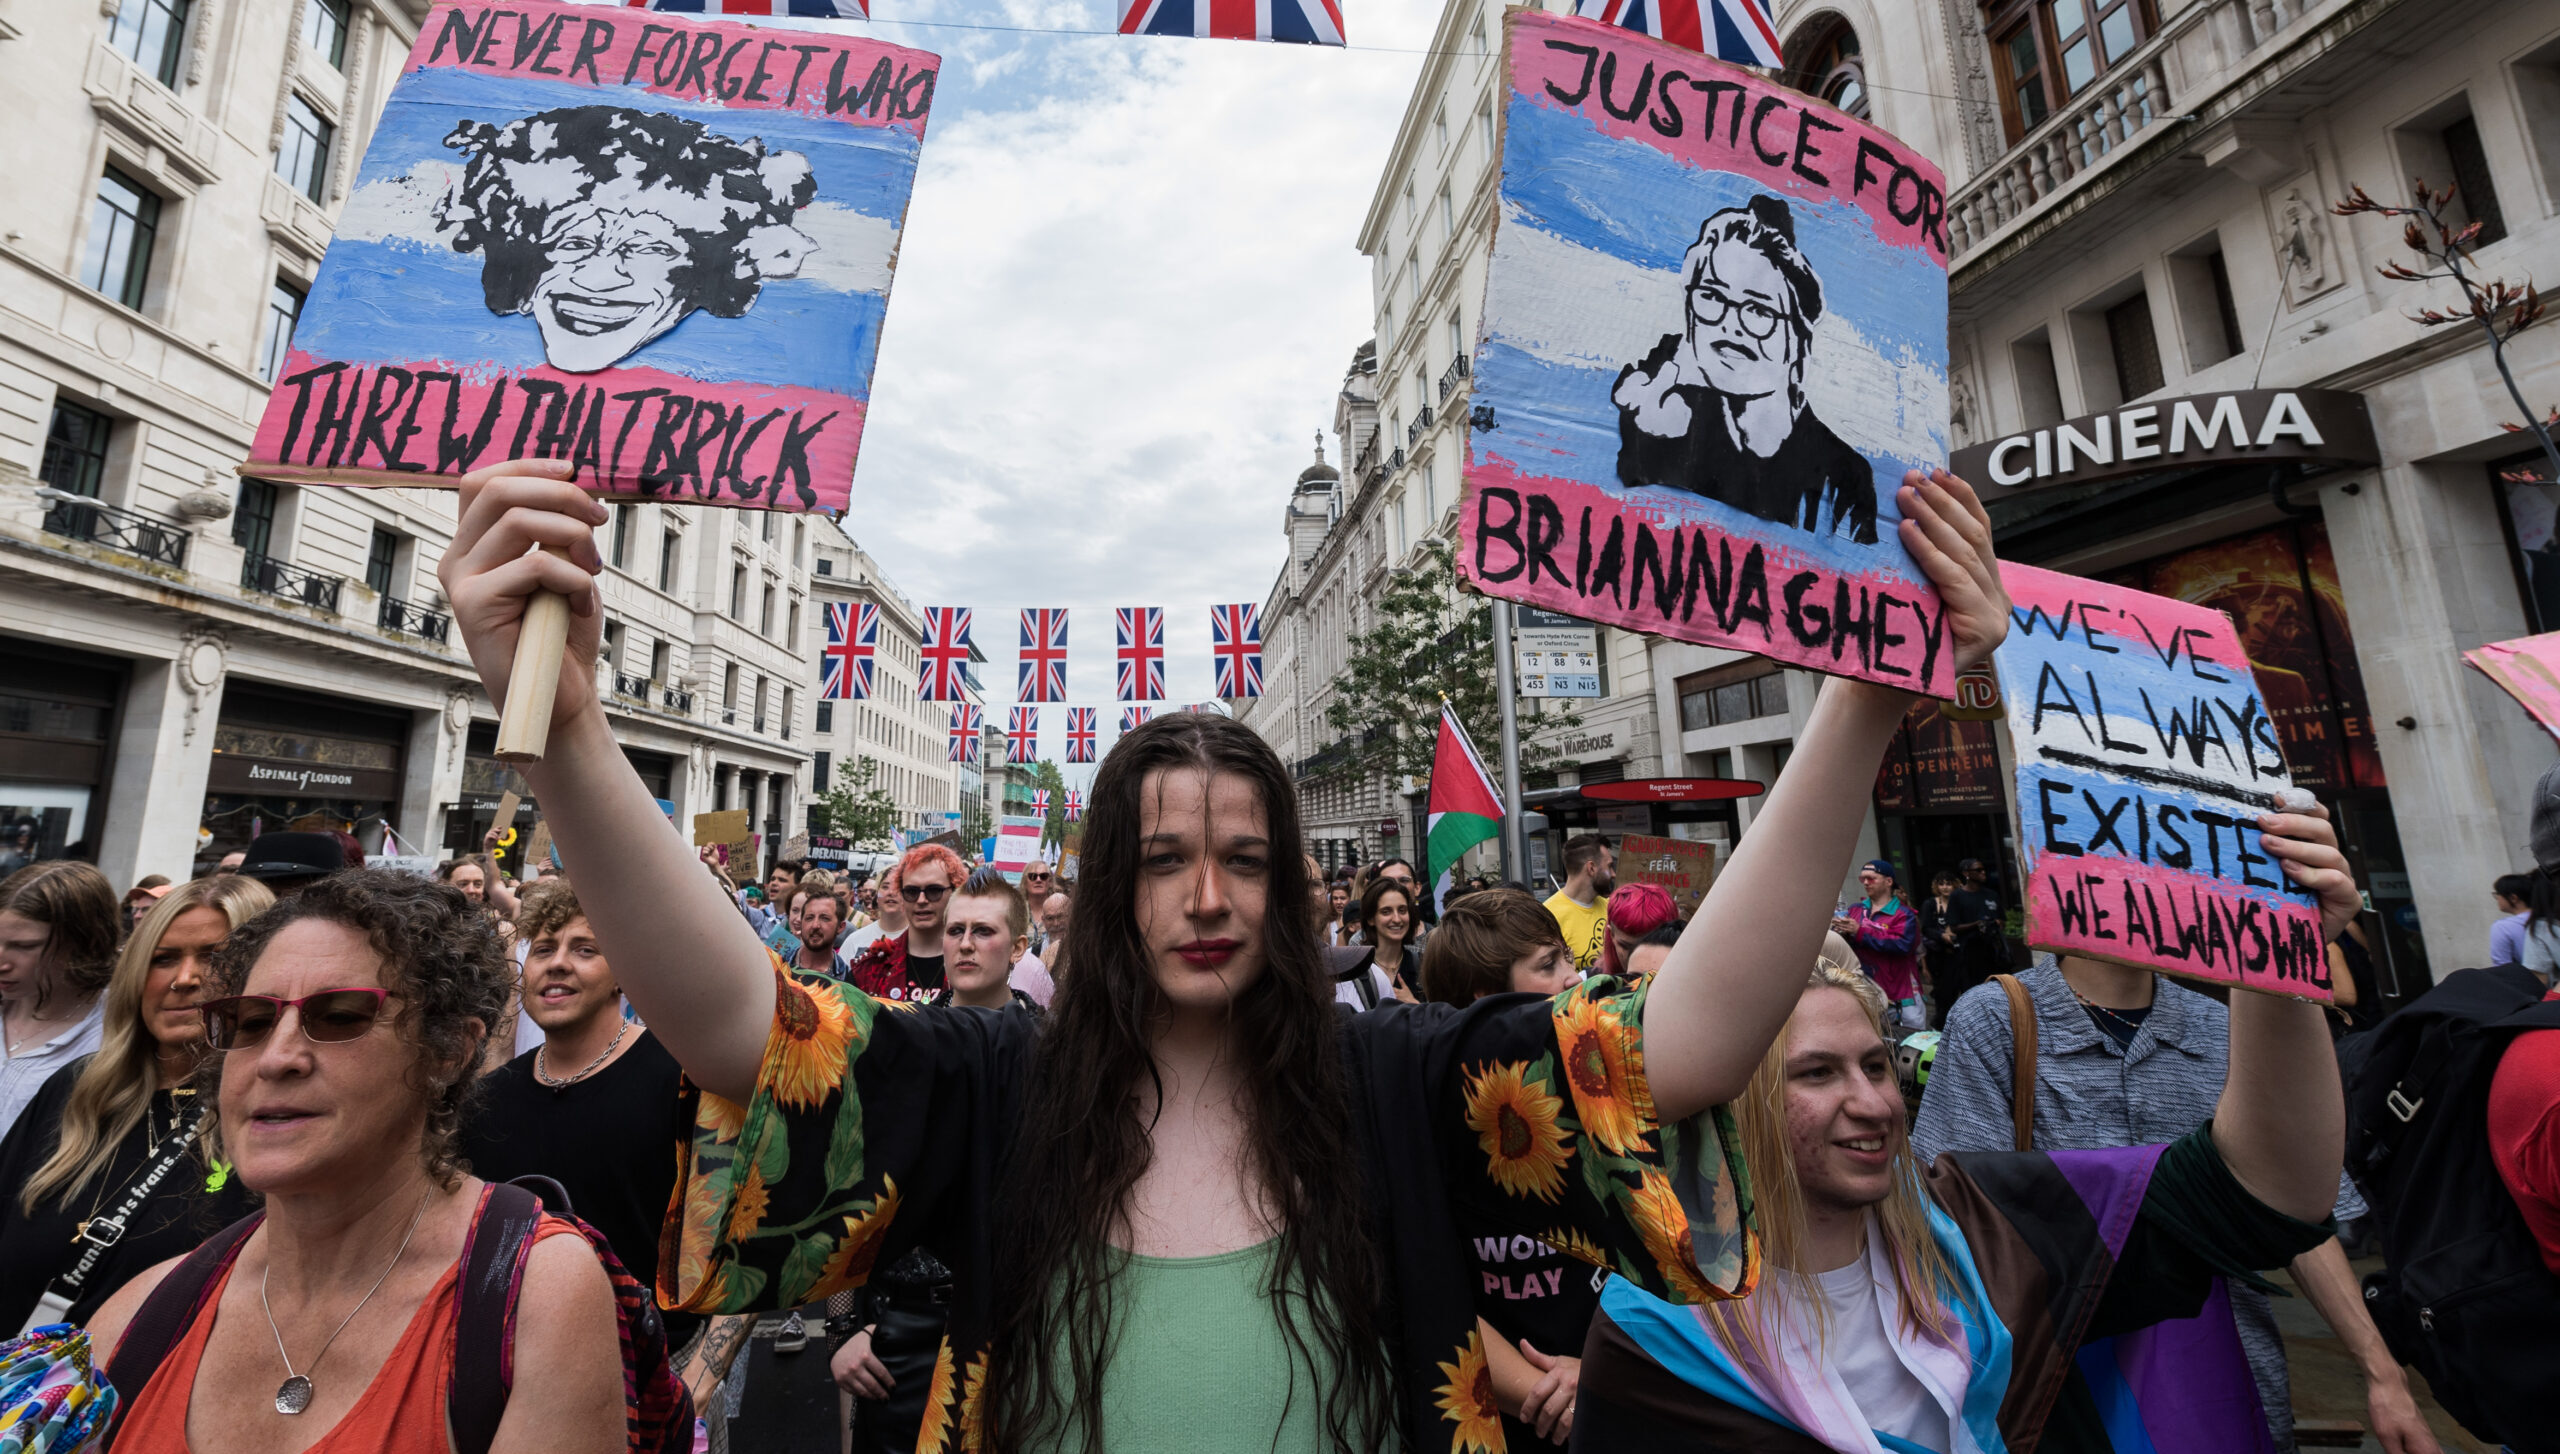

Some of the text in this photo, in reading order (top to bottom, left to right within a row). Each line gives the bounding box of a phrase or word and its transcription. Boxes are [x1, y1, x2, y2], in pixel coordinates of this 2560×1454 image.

[428, 8, 939, 122] NEVER FORGET WHO
[1543, 40, 1946, 254] JUSTICE FOR
[281, 361, 841, 509] THREW THAT BRICK
[1988, 393, 2325, 486] CINEMA
[1475, 487, 1946, 691] BRIANNA GHEY
[2011, 599, 2232, 685] WE'VE
[1527, 658, 1591, 666] 12 88 94
[1526, 681, 1597, 690] 453 N3 N15
[2033, 661, 2288, 782] ALWAYS
[1563, 733, 1614, 756] WAREHOUSE
[921, 812, 932, 826] NO
[816, 836, 844, 848] TRANS
[1622, 835, 1709, 858] IGNORANCE
[731, 862, 751, 873] LIVE
[1637, 871, 1690, 888] SILENCE
[1649, 859, 1677, 872] FEAR
[2049, 870, 2117, 940] WE
[2123, 878, 2270, 980] ALWAYS
[1481, 1267, 1564, 1301] PLAY
